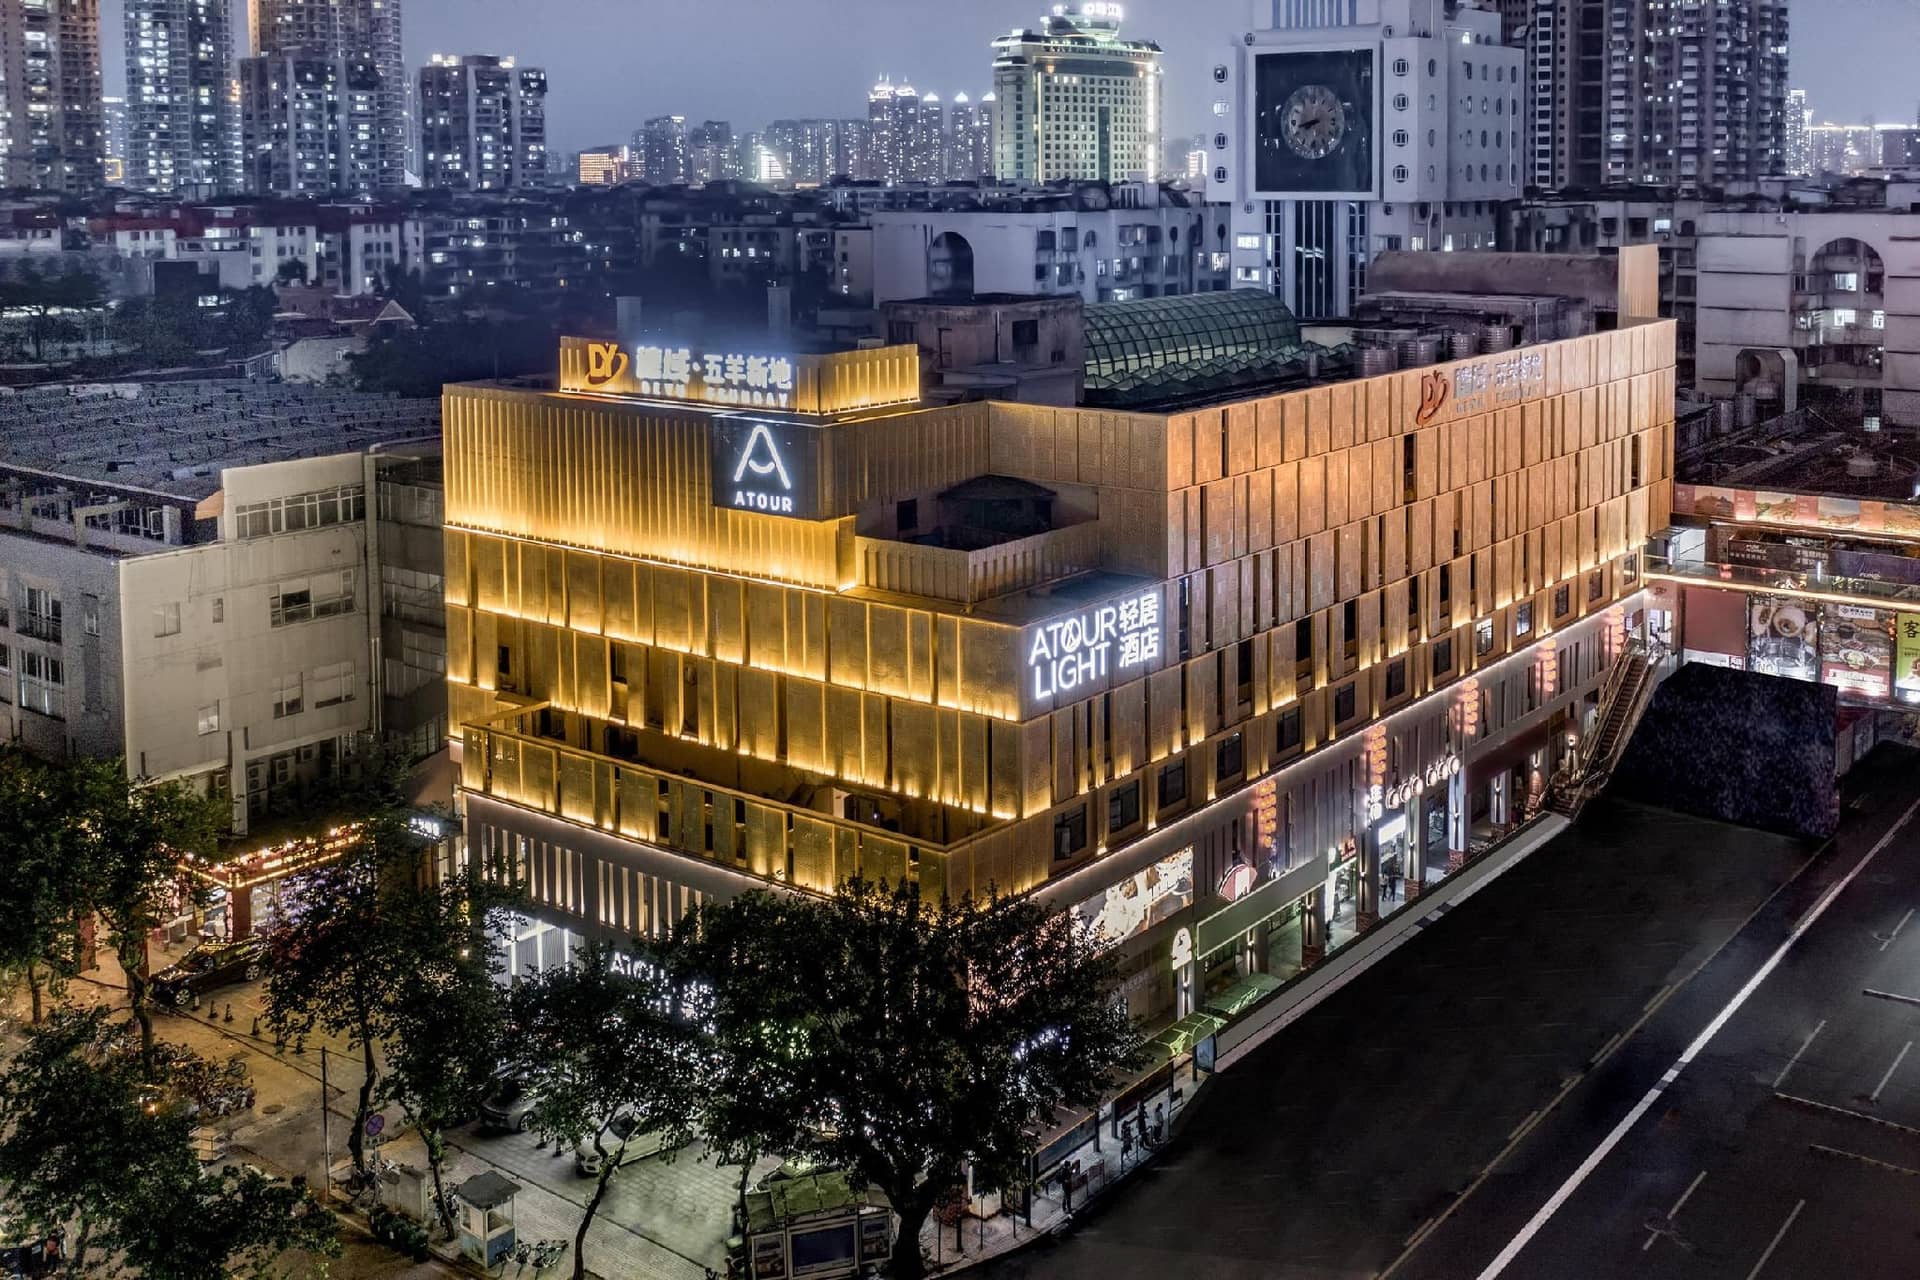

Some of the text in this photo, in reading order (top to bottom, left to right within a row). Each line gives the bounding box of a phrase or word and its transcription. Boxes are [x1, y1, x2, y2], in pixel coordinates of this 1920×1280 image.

[735, 490, 793, 513] ATOUR
[1119, 592, 1159, 633] 轻居
[1028, 605, 1118, 667] ATOUR
[1119, 627, 1160, 668] 酒店
[1035, 641, 1112, 700] LIGHT
